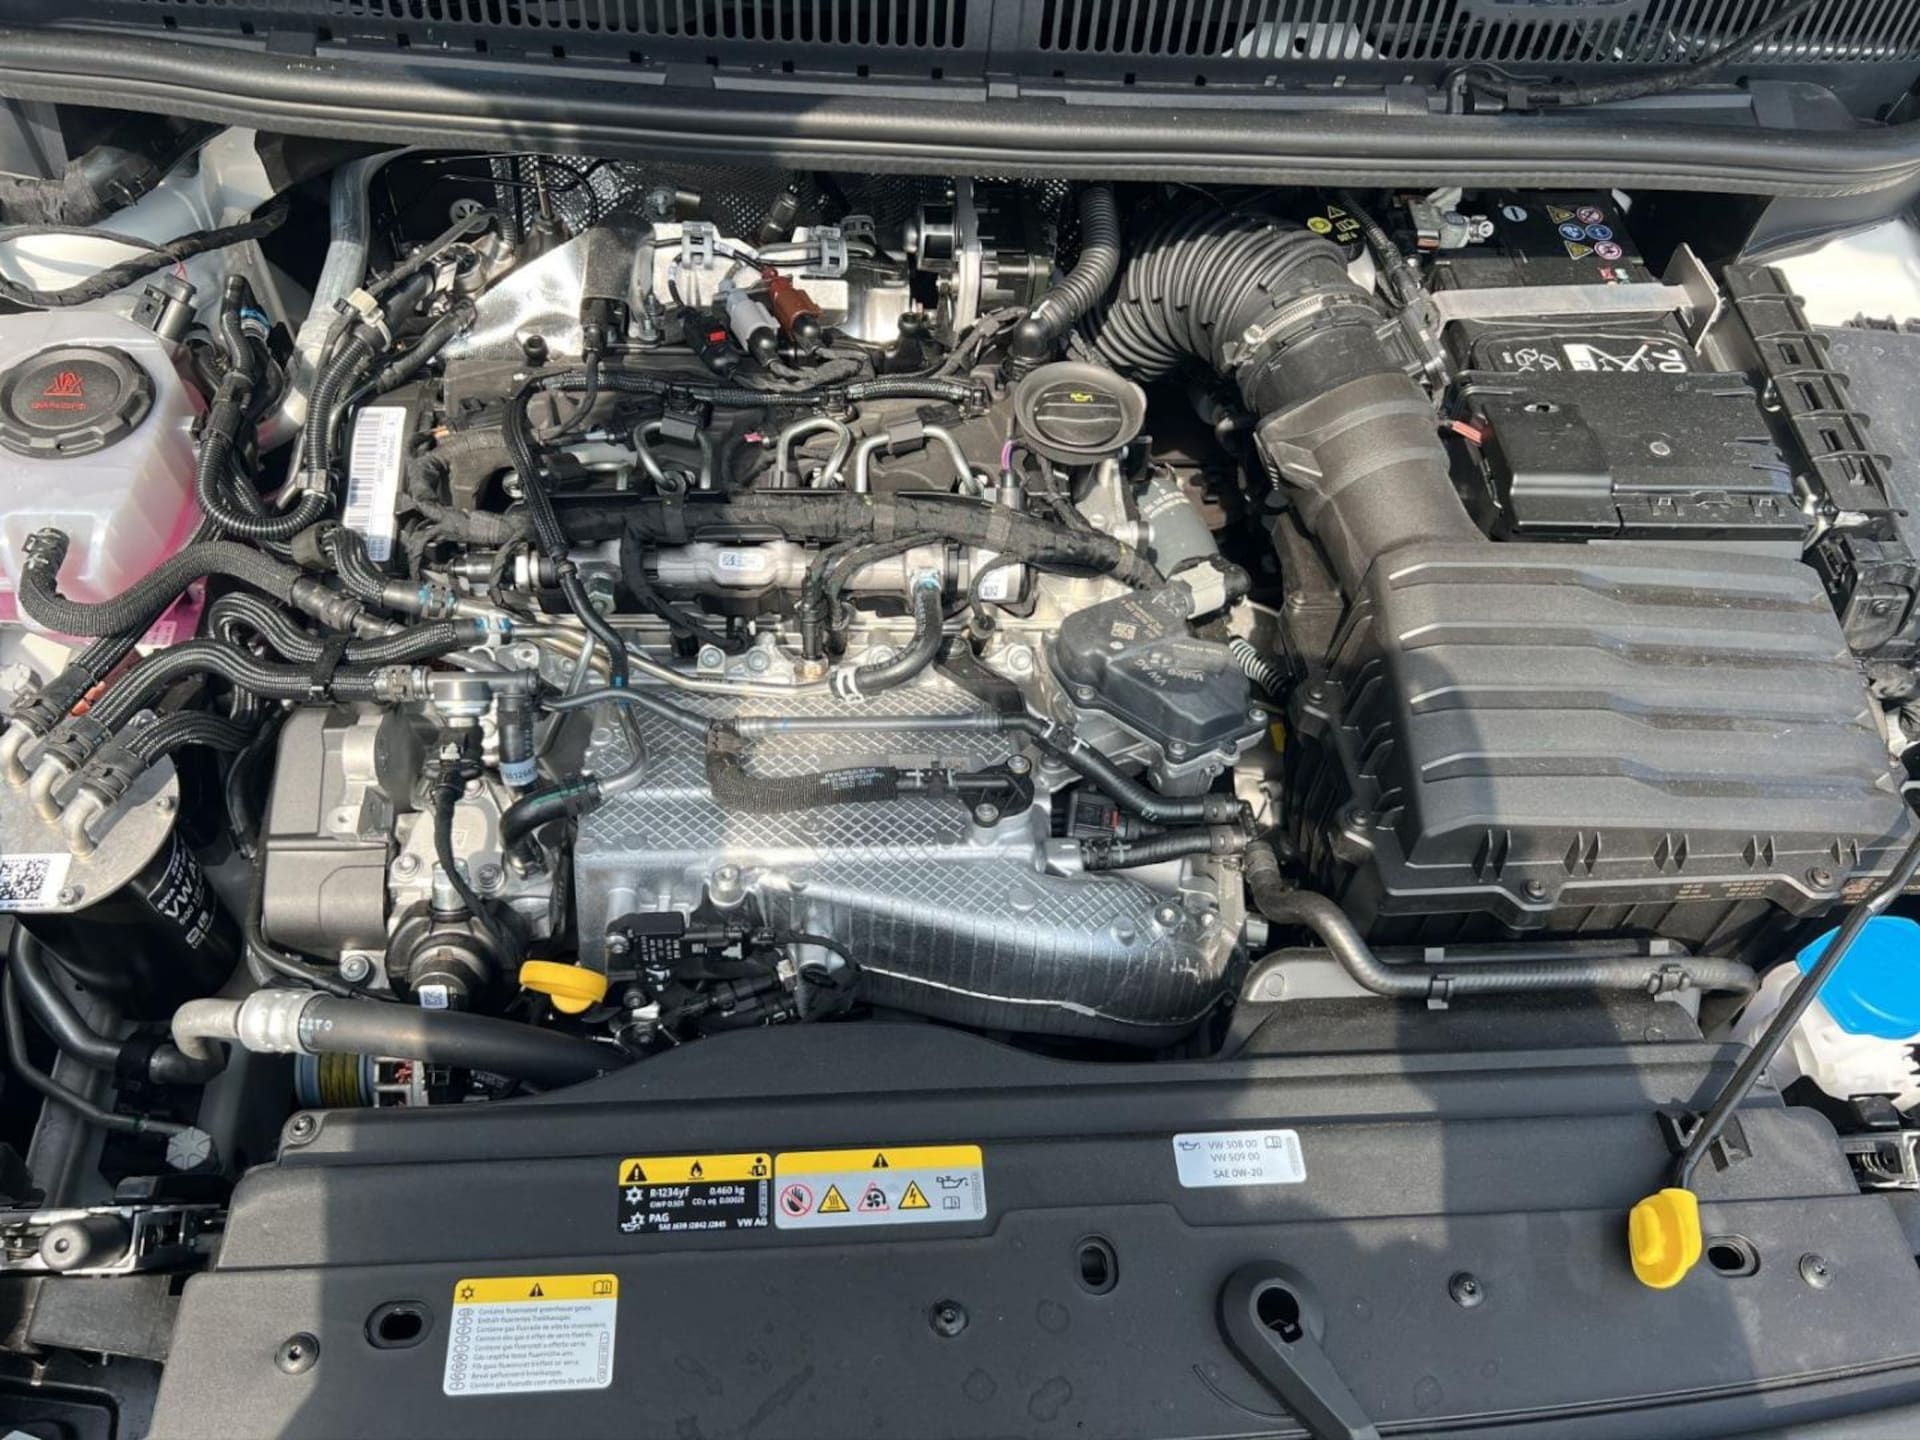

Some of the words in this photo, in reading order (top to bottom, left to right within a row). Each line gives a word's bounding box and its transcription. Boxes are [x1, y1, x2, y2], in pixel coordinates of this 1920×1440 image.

[1208, 1140, 1224, 1150] VW
[1225, 1139, 1244, 1149] 508
[1246, 1138, 1258, 1149] 00
[1210, 1153, 1227, 1163] VW
[1228, 1152, 1246, 1162] 509
[1247, 1151, 1261, 1161] 00
[1213, 1169, 1231, 1179] SAE
[734, 1185, 746, 1196] kg
[648, 1213, 670, 1223] PAG
[736, 1217, 754, 1228] VW
[754, 1217, 768, 1227] AG
